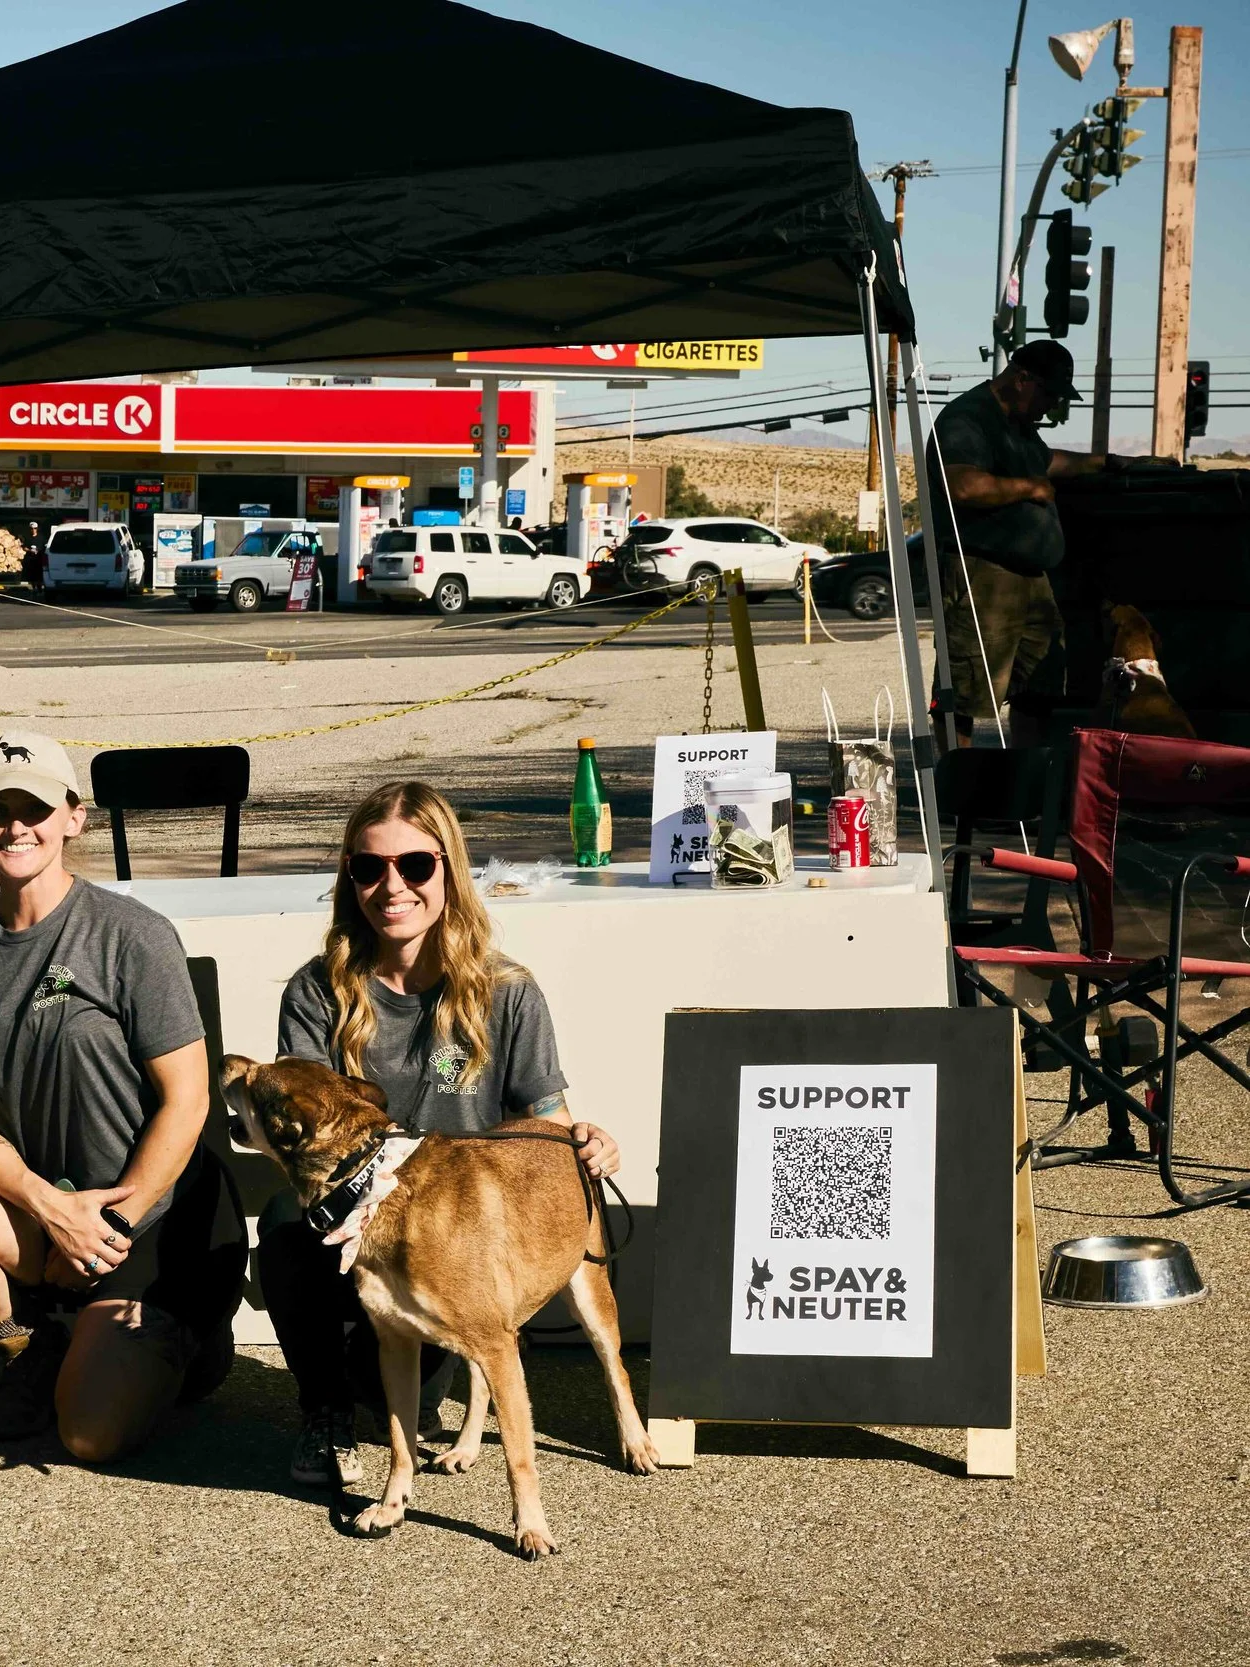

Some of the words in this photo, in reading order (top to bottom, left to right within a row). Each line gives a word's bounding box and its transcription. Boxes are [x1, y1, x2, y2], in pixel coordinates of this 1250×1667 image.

[643, 342, 759, 362] CIGARETTES
[9, 402, 109, 426] CIRCLE
[117, 398, 151, 434] K
[677, 749, 749, 763] SUPPORT
[56, 965, 75, 981] PAWS
[32, 993, 70, 1011] FOSTER
[429, 1044, 459, 1066] PALMS
[437, 1084, 478, 1095] FOSTER
[757, 1086, 911, 1109] SUPPORT
[789, 1266, 907, 1293] SPAY&
[772, 1296, 908, 1321] NEUTER
